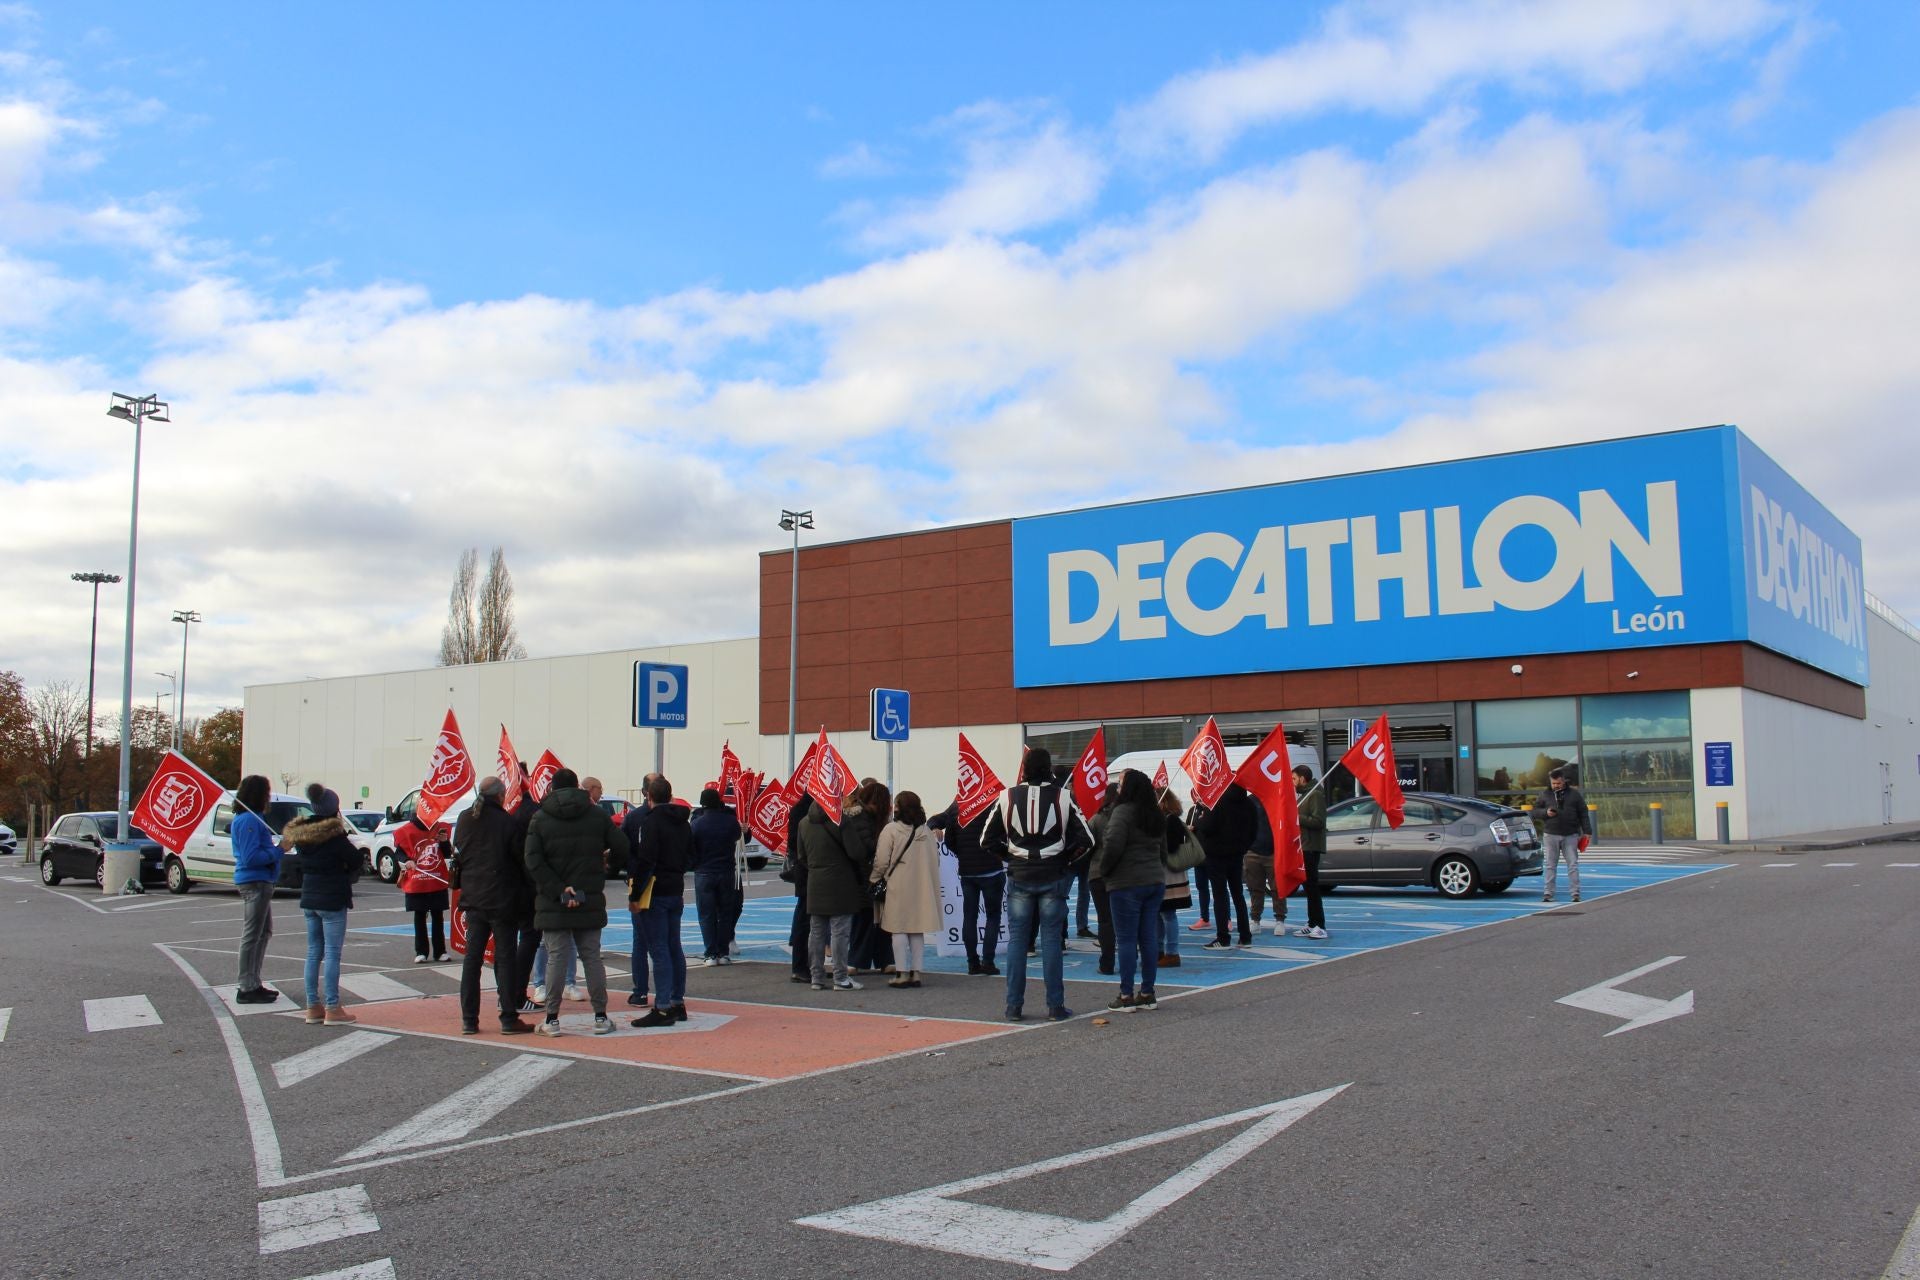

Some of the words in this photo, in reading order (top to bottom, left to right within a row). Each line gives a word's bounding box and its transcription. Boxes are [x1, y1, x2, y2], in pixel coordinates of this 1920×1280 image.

[1048, 480, 1684, 646] DECATHLON
[1751, 483, 1864, 651] DECATHLON
[1611, 603, 1686, 634] León
[649, 670, 679, 720] P
[660, 712, 685, 721] MOTOS
[1200, 740, 1219, 775] UGT
[153, 775, 188, 821] UGT
[758, 795, 783, 826] UGT
[961, 786, 996, 817] www.ugt.es
[140, 818, 178, 846] www.ugt.es
